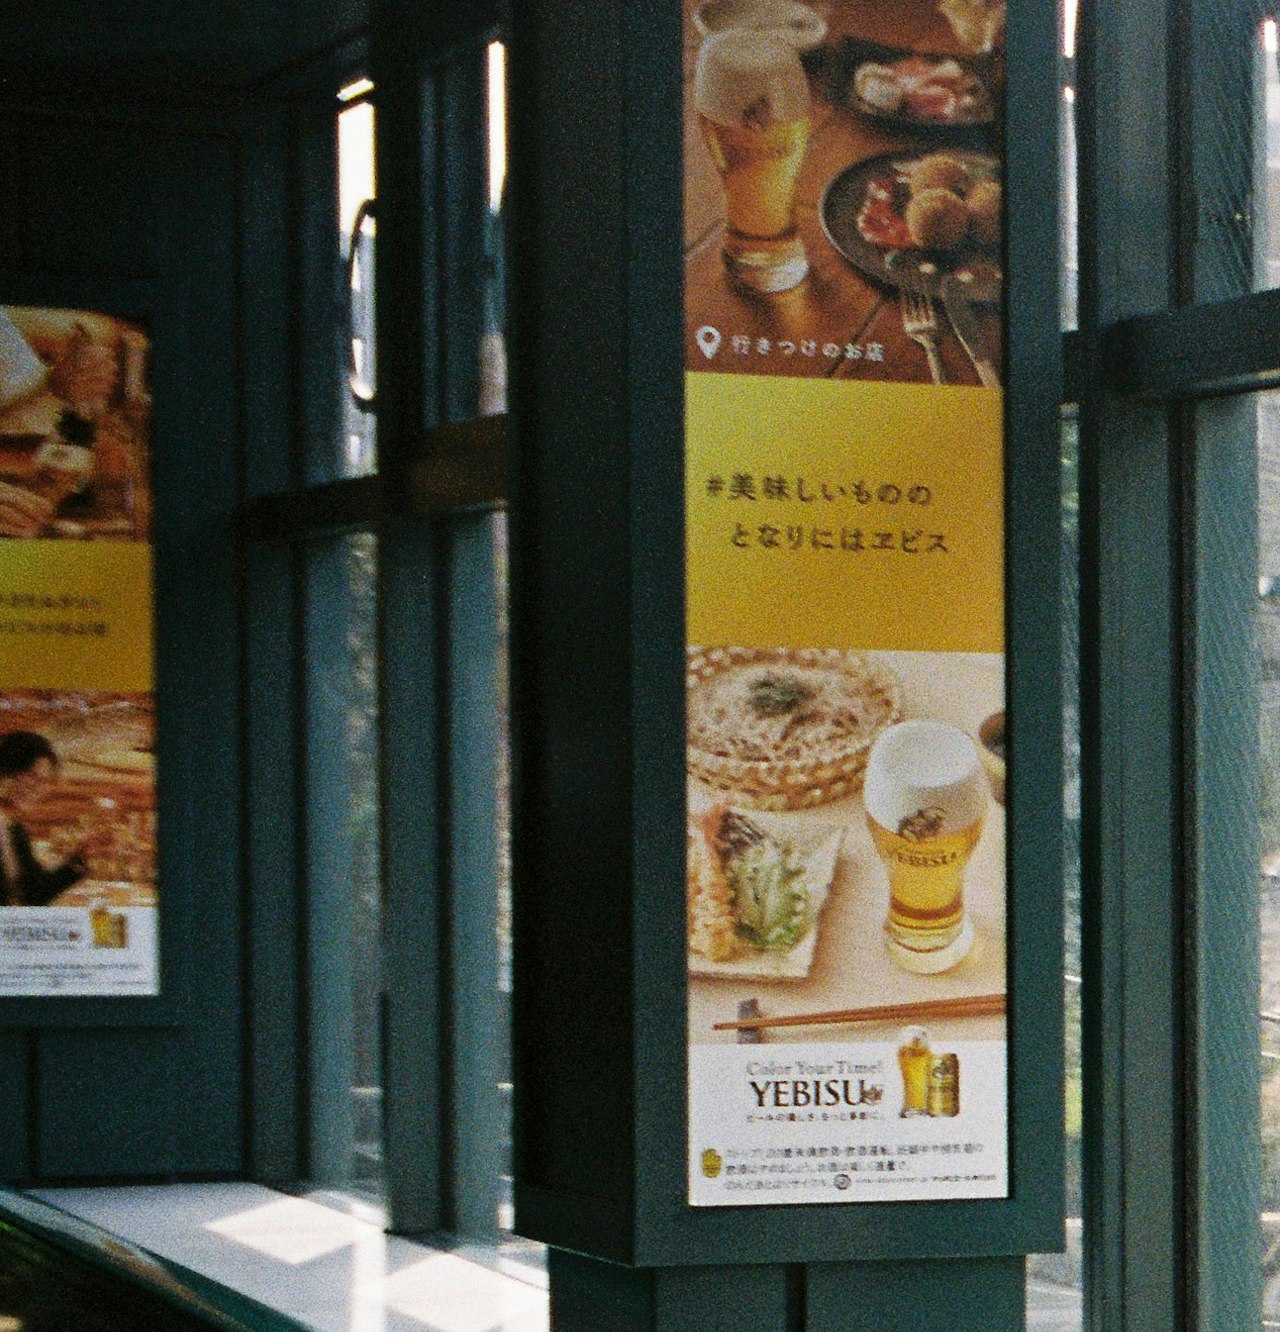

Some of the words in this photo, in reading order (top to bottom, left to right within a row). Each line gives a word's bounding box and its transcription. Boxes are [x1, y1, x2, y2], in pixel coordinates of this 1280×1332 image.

[731, 334, 886, 362] 行きつけのお店
[705, 471, 933, 506] #美味しいものの
[730, 522, 950, 554] となりにはエビス
[796, 1060, 834, 1075] Your
[749, 1079, 866, 1107] YEBISU
